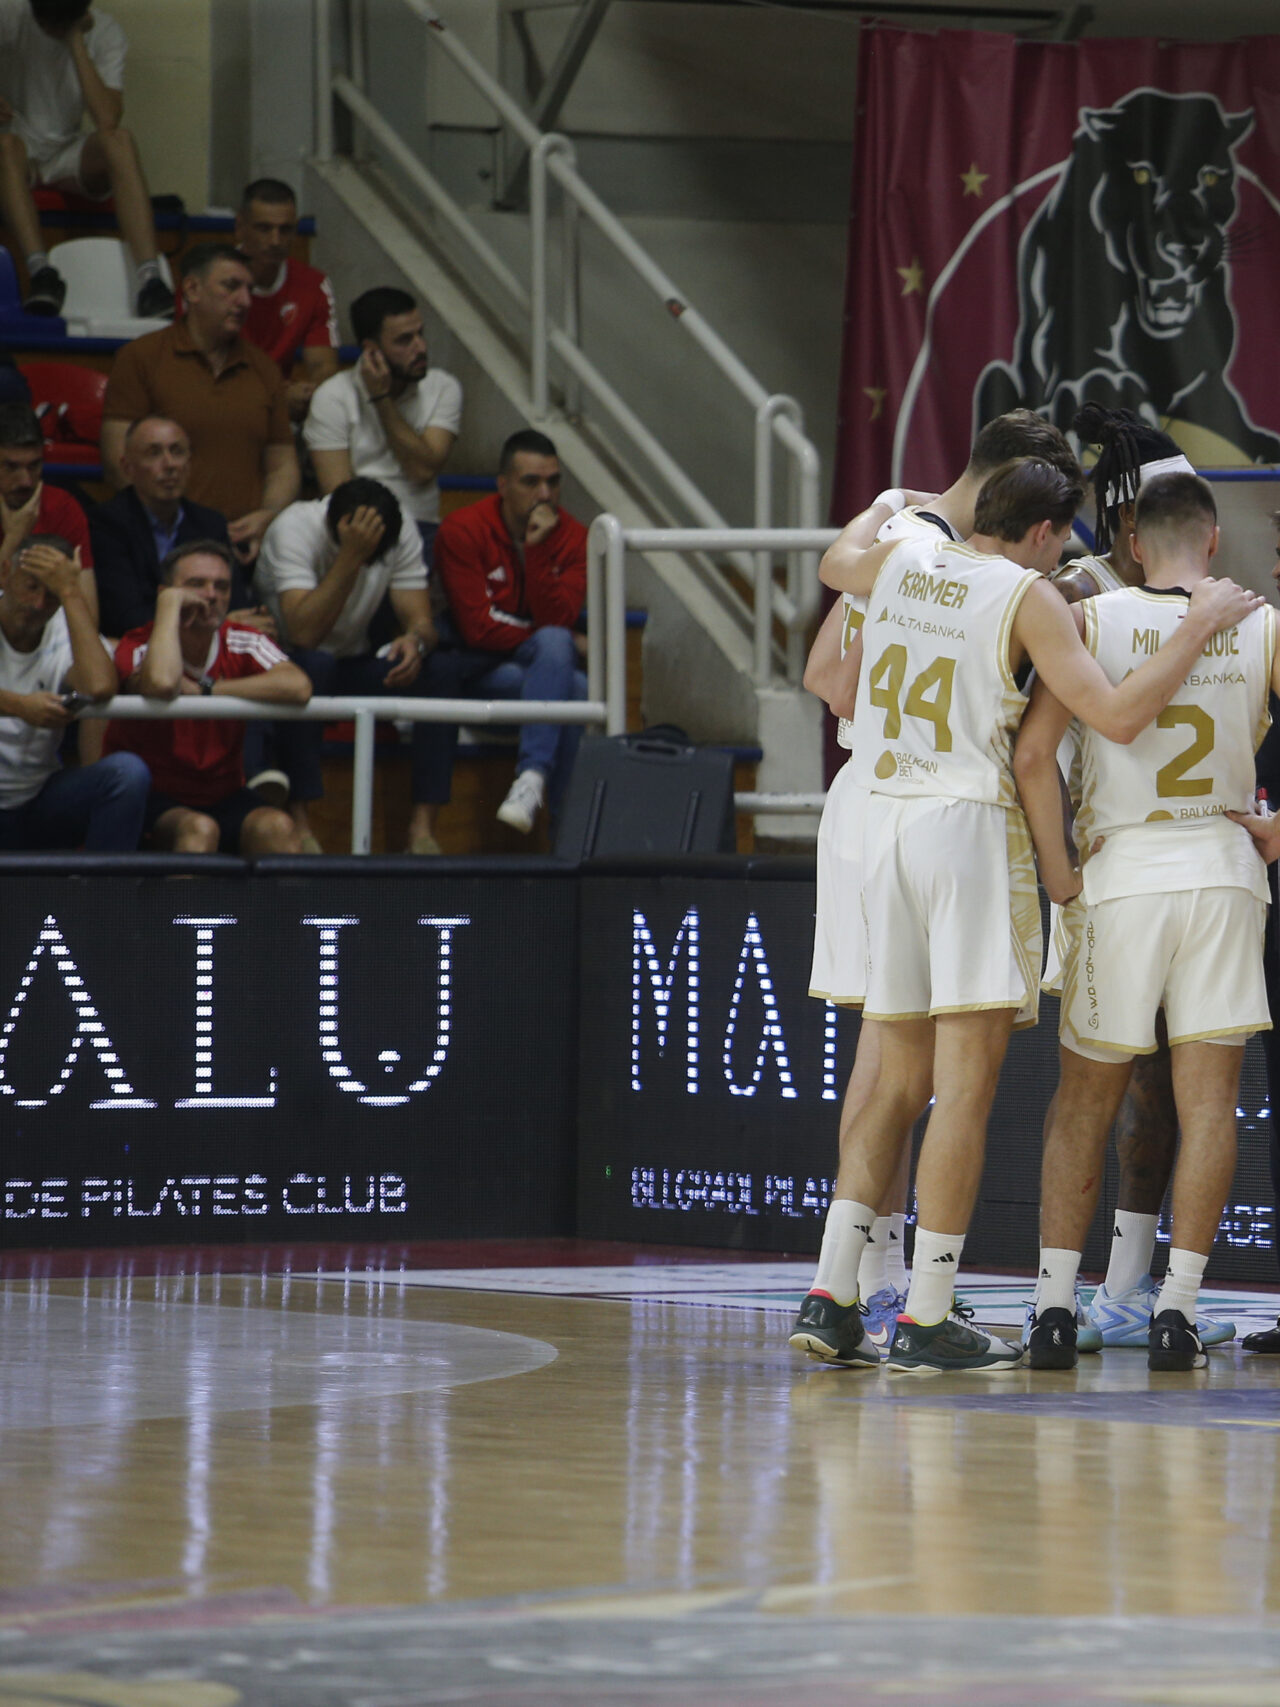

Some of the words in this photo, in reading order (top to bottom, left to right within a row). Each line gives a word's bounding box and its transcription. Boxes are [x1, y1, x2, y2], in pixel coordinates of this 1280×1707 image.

[890, 612, 967, 642] ALTABANKA
[1132, 627, 1240, 657] MILOVIĆ
[1183, 672, 1247, 687] BANKA
[868, 642, 958, 753] 44
[896, 752, 938, 774] BALKAN
[1156, 704, 1215, 798] 2
[899, 765, 913, 778] BET
[631, 905, 838, 1101] MA
[82, 1176, 269, 1217] PILATES
[282, 1173, 408, 1215] CLUB
